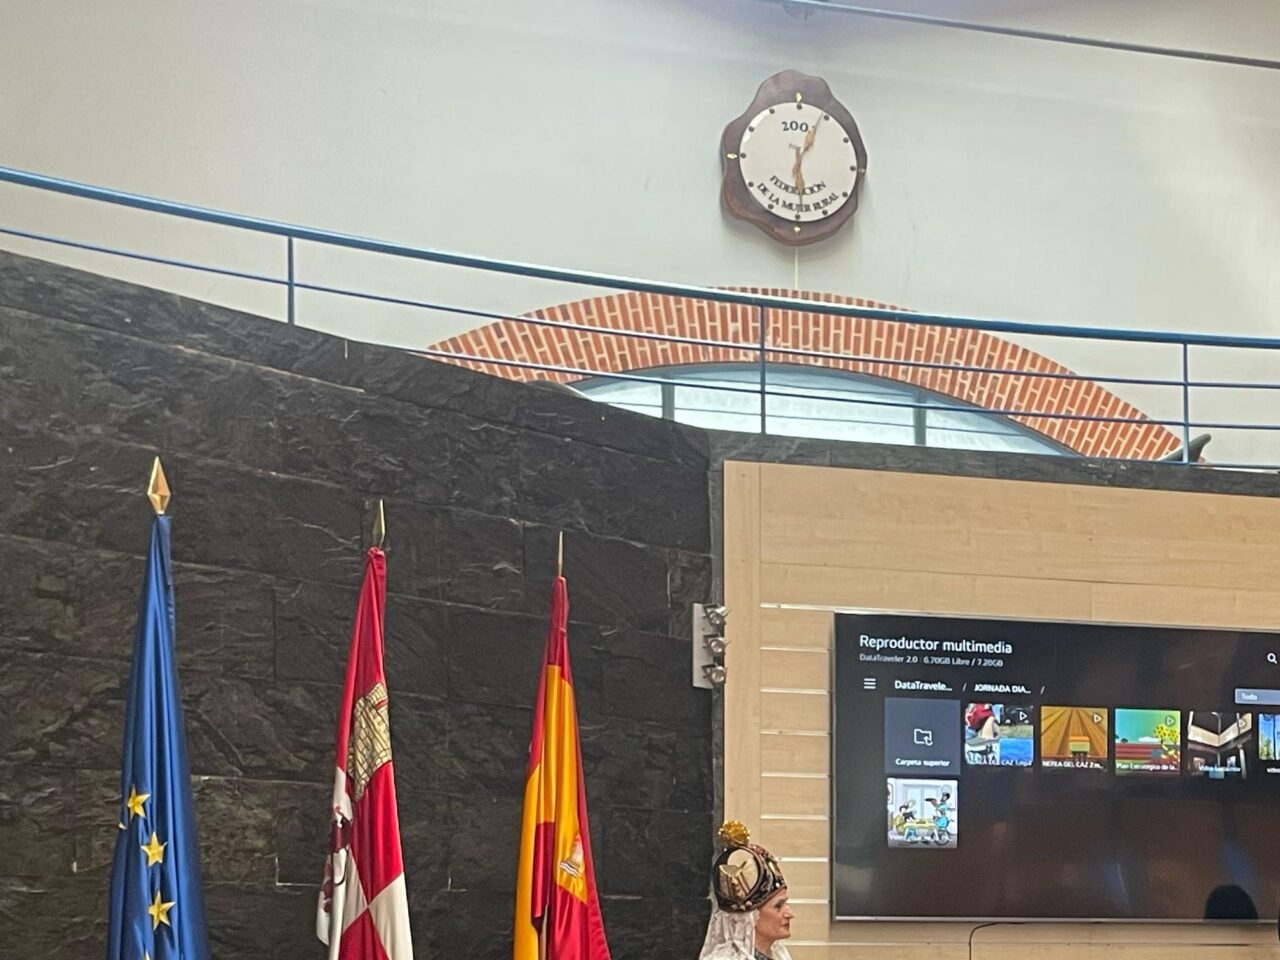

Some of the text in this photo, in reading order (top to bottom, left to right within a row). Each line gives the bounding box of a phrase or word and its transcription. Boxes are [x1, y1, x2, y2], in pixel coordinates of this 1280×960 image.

[781, 120, 817, 134] 200
[757, 182, 840, 214] DE LA MUJER RURAL
[859, 634, 1013, 654] Reproductor multimedia
[859, 653, 905, 663] DataTraveler
[905, 655, 918, 664] 2.0
[973, 683, 1011, 693] JORNADA
[895, 757, 951, 768] Carpeta superior
